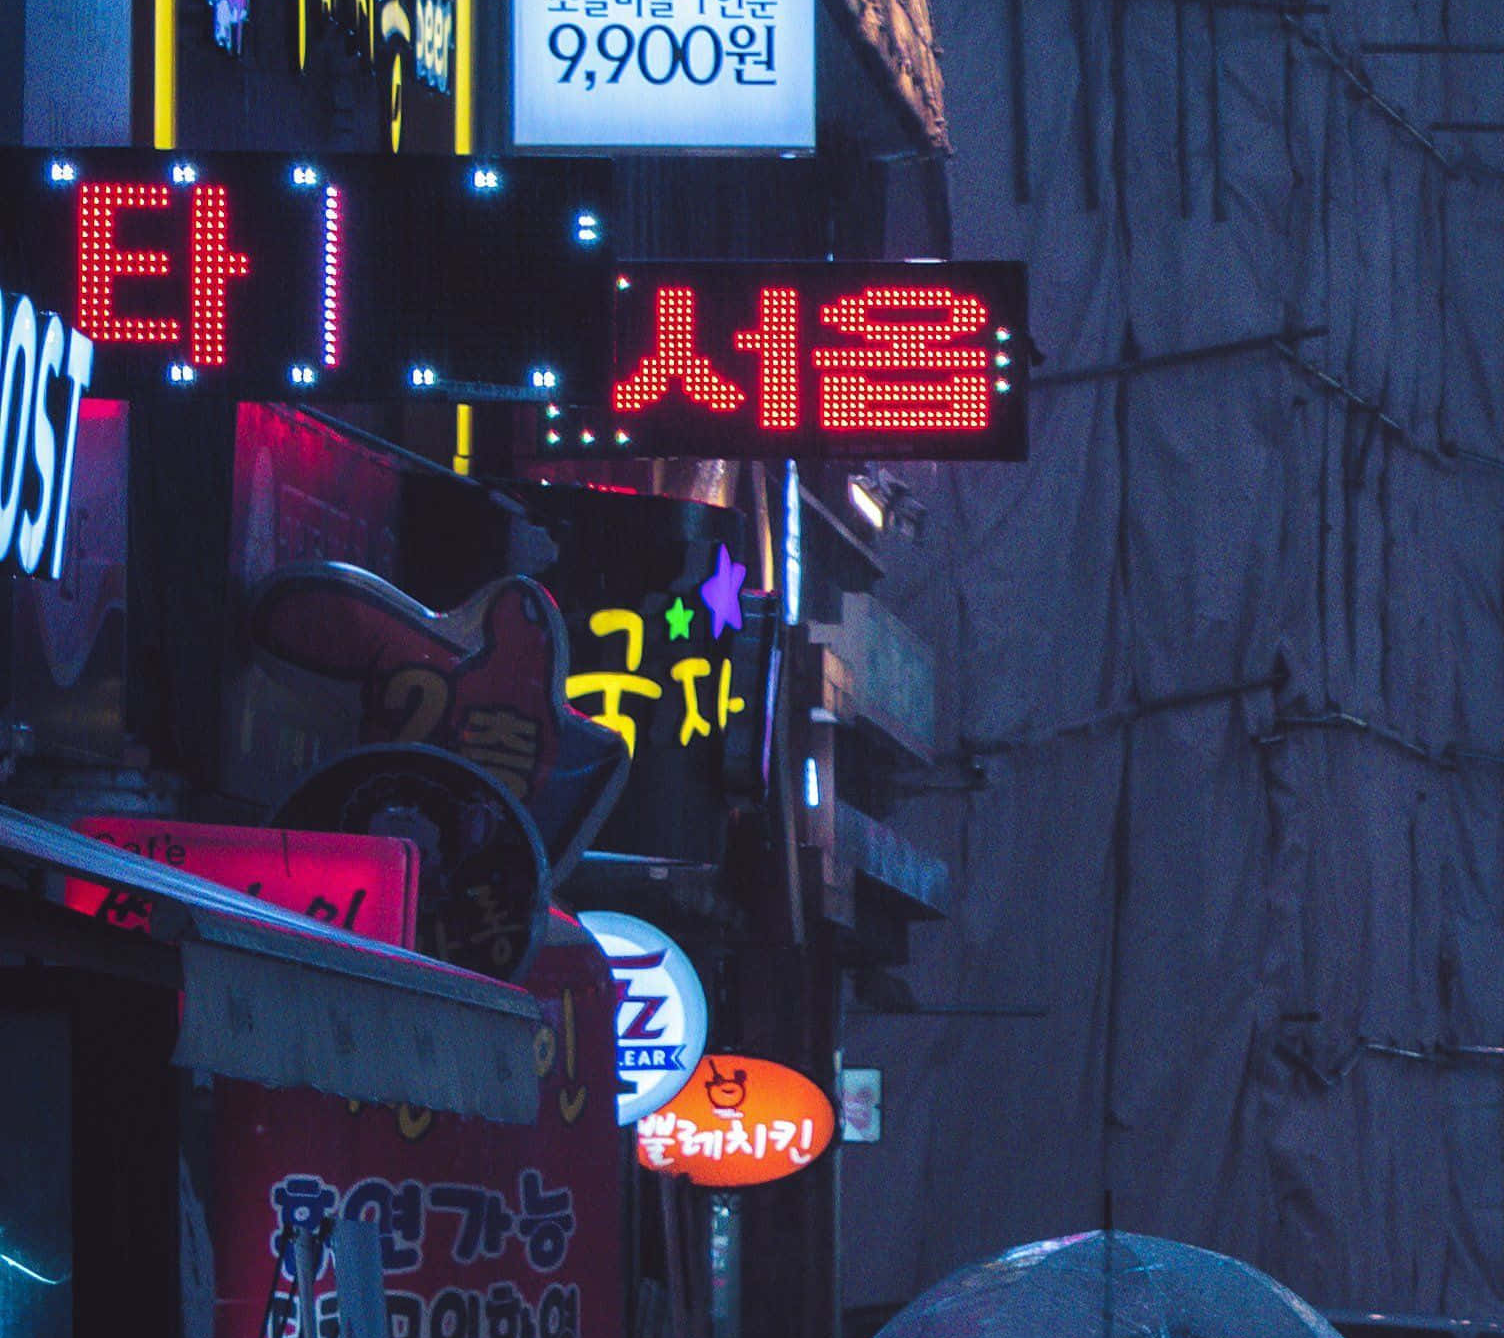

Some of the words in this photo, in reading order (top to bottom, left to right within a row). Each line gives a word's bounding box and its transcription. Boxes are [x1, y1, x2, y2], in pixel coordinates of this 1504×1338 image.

[548, 24, 779, 89] 9,900원
[612, 286, 992, 431] 서울
[565, 609, 744, 759] 국자
